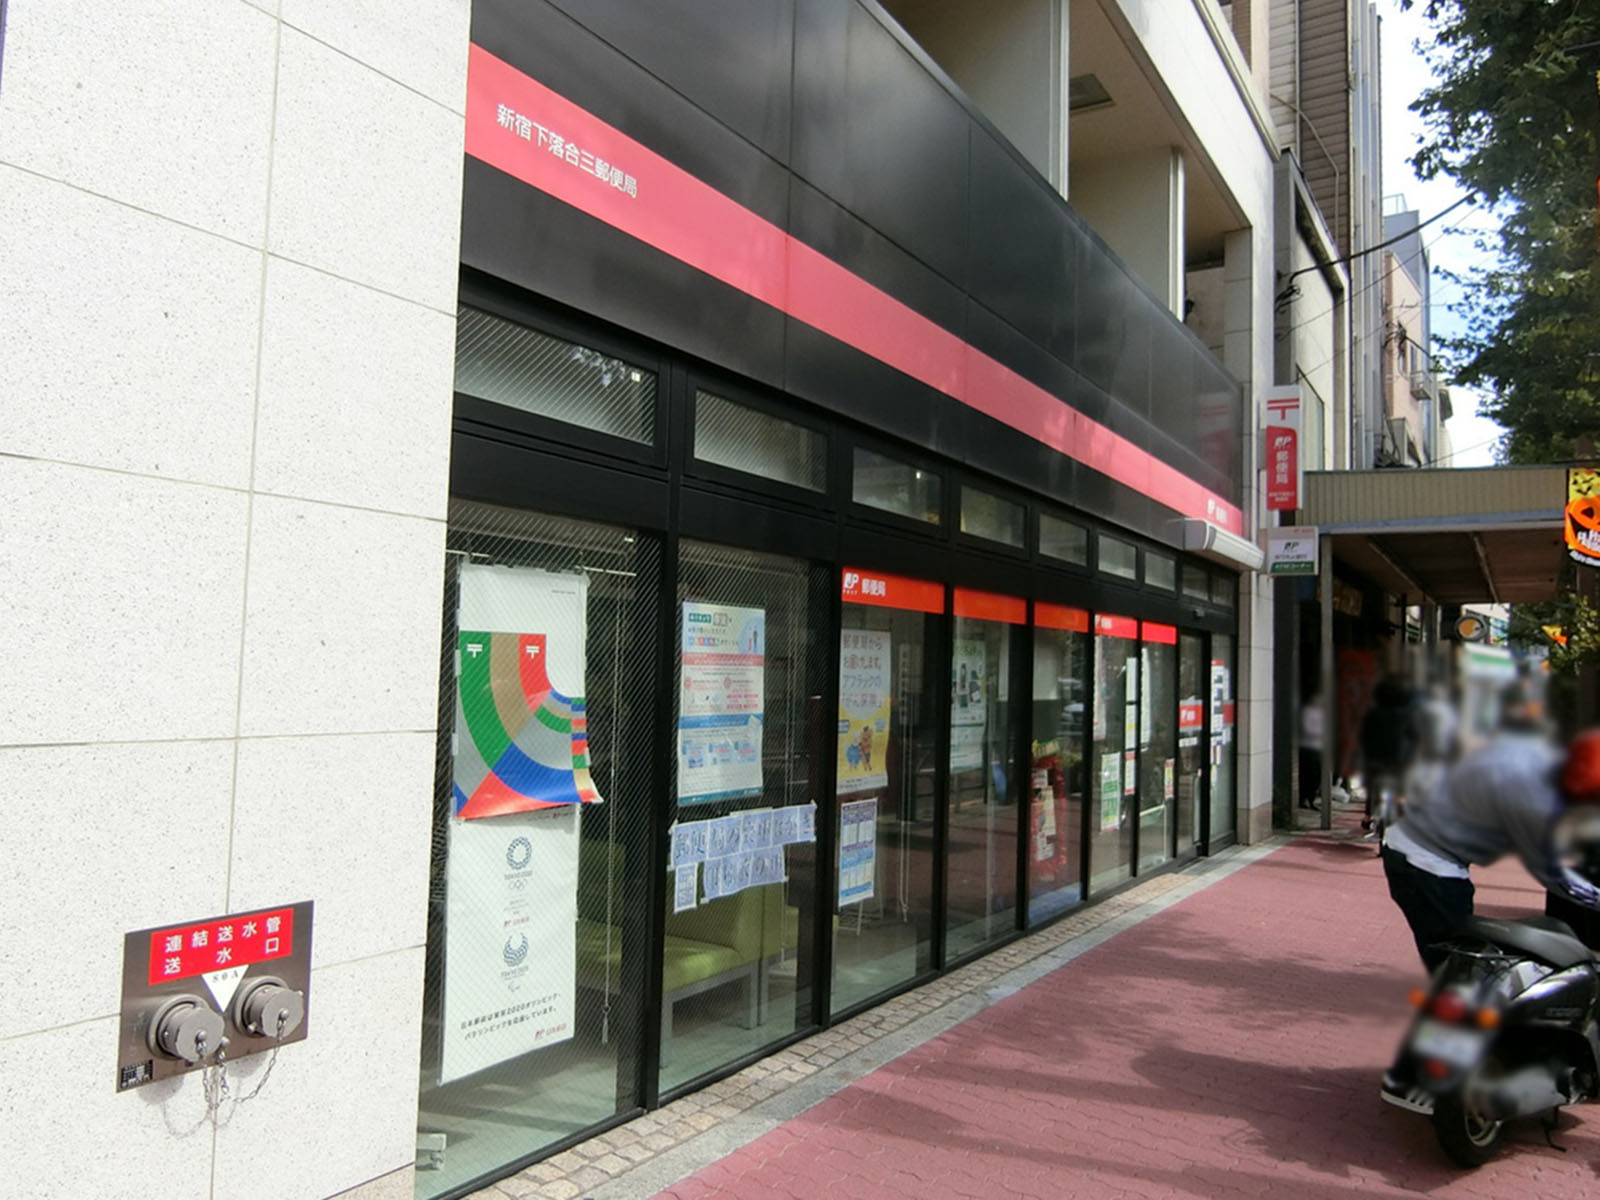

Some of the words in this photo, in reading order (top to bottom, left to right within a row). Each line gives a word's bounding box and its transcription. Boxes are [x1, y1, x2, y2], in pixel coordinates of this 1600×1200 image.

[497, 104, 637, 198] 新宿下落合三郵便局
[862, 578, 886, 597] 郵便局
[165, 916, 281, 952] 連結送水管
[164, 938, 279, 974] 送水口
